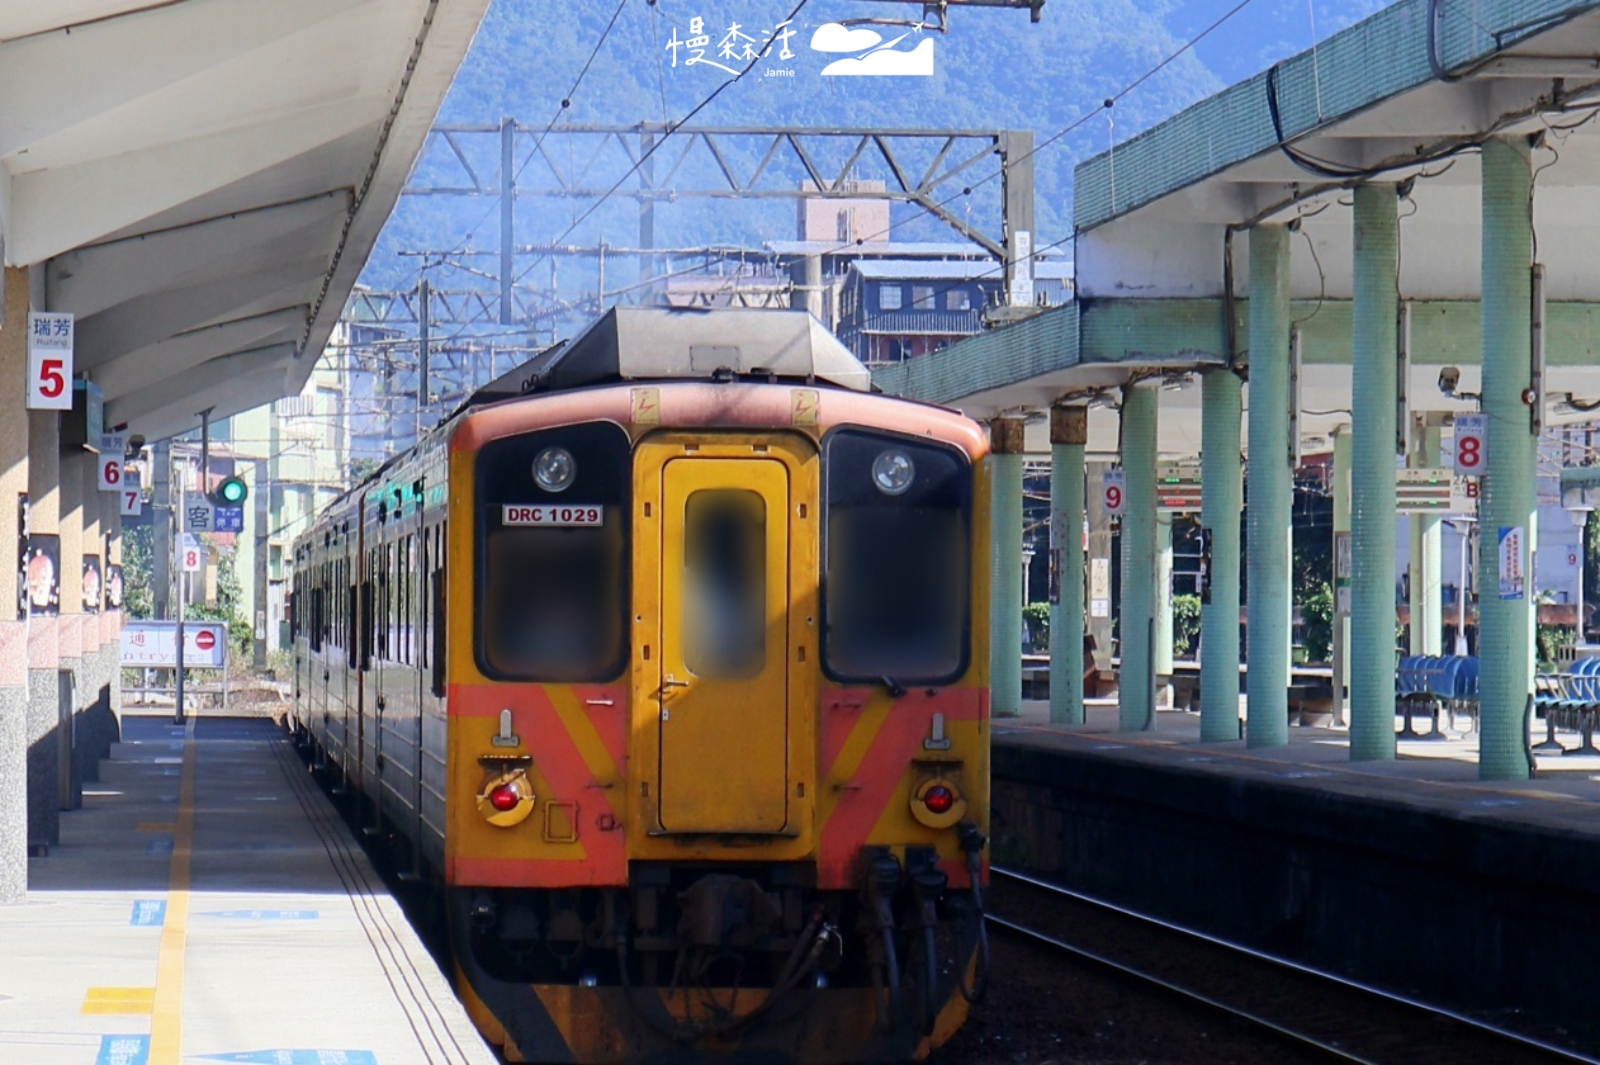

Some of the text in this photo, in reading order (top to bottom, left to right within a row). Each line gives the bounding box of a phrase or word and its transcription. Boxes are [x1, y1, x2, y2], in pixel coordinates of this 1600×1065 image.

[34, 318, 71, 337] 瑞芳
[39, 360, 64, 398] 5
[1459, 436, 1480, 467] 8
[104, 461, 120, 485] 6
[1106, 486, 1121, 509] 9
[1467, 483, 1478, 497] B
[125, 492, 137, 510] 7
[188, 506, 209, 528] 客
[508, 508, 598, 522] DRC 1029
[186, 551, 196, 567] 8
[1568, 553, 1577, 566] 9
[123, 650, 169, 662] ntry
